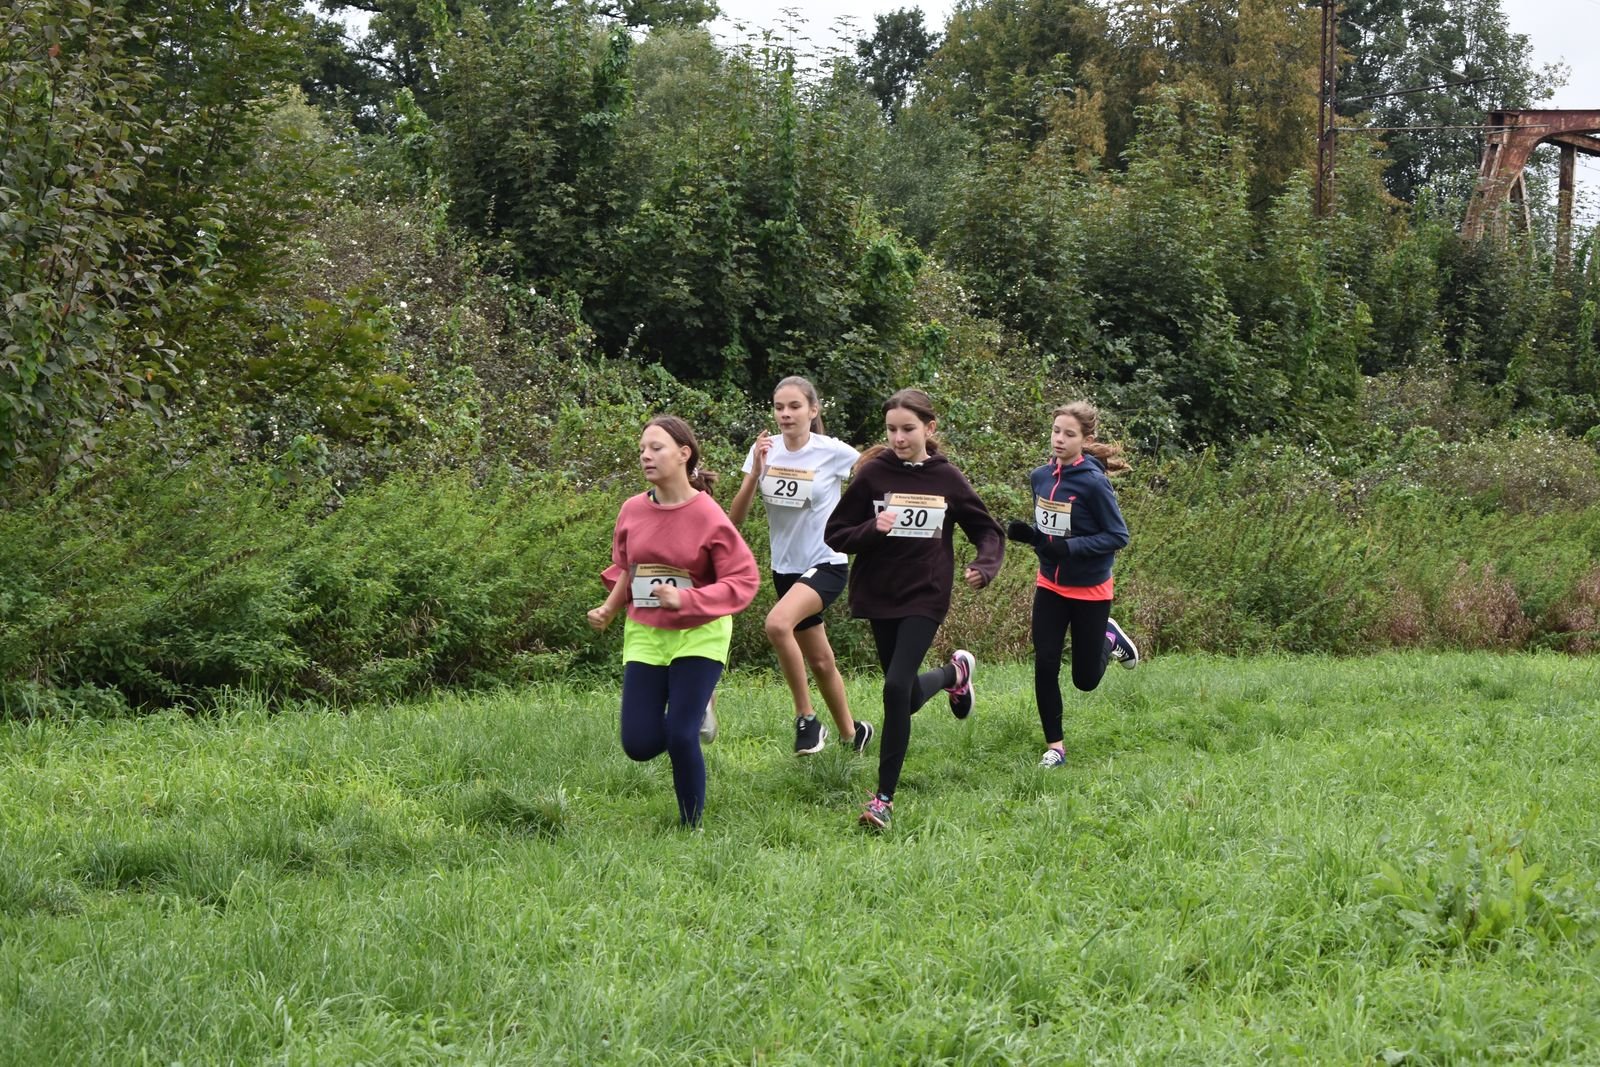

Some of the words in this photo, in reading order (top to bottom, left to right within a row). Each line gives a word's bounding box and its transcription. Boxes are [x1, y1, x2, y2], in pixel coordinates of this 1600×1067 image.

[774, 479, 798, 497] 29
[900, 508, 928, 527] 30
[1042, 511, 1057, 527] 31
